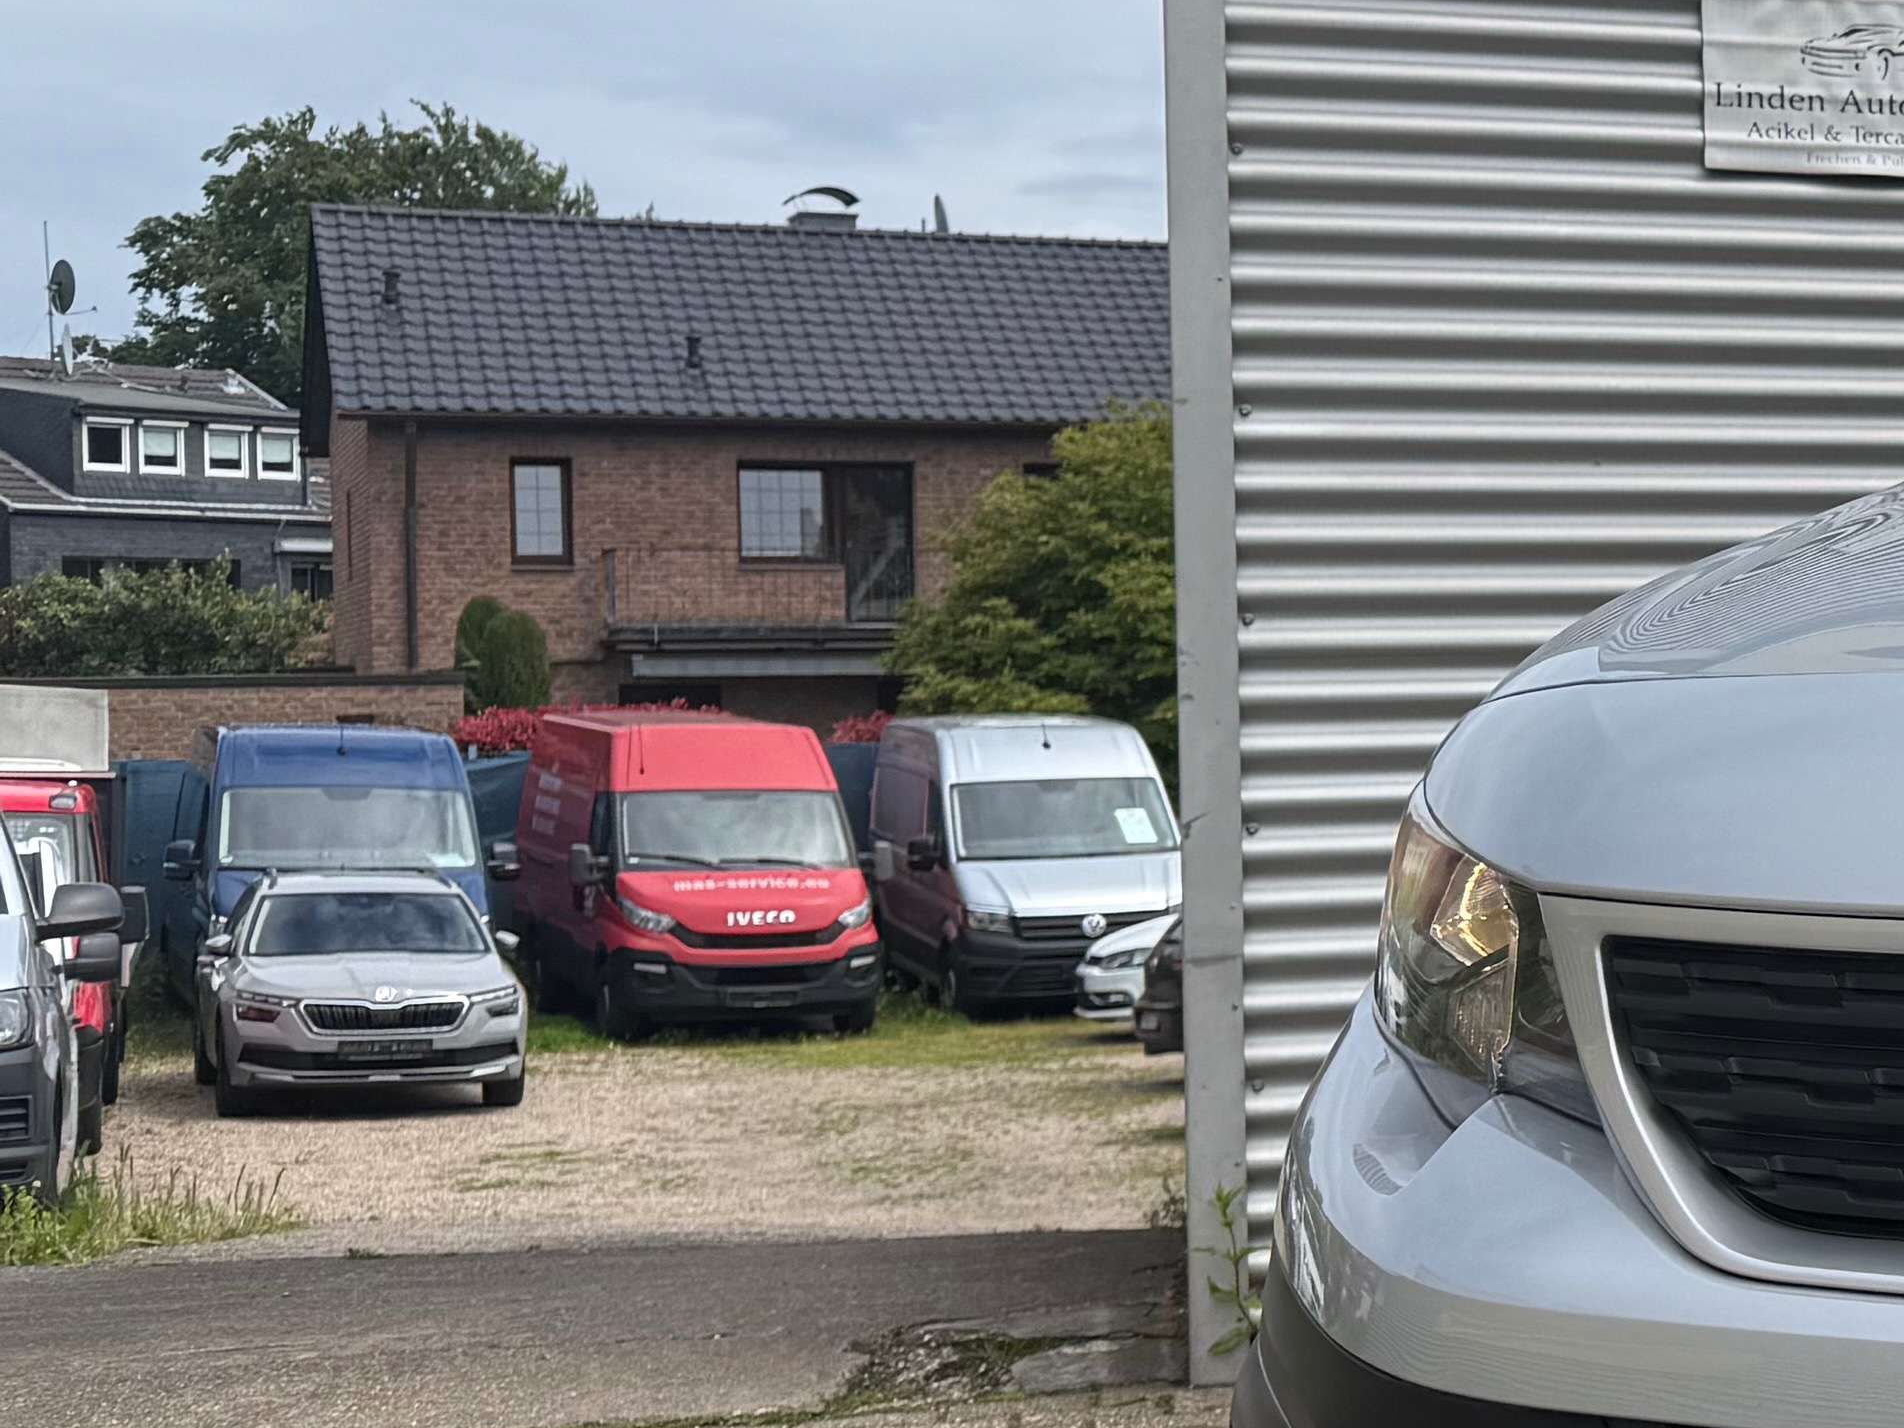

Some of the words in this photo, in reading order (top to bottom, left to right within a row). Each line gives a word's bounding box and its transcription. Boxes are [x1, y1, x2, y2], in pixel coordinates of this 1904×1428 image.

[1714, 82, 1825, 113] Linden
[1747, 121, 1814, 141] Acikel
[1824, 125, 1842, 142] &
[726, 909, 796, 927] IVECO
